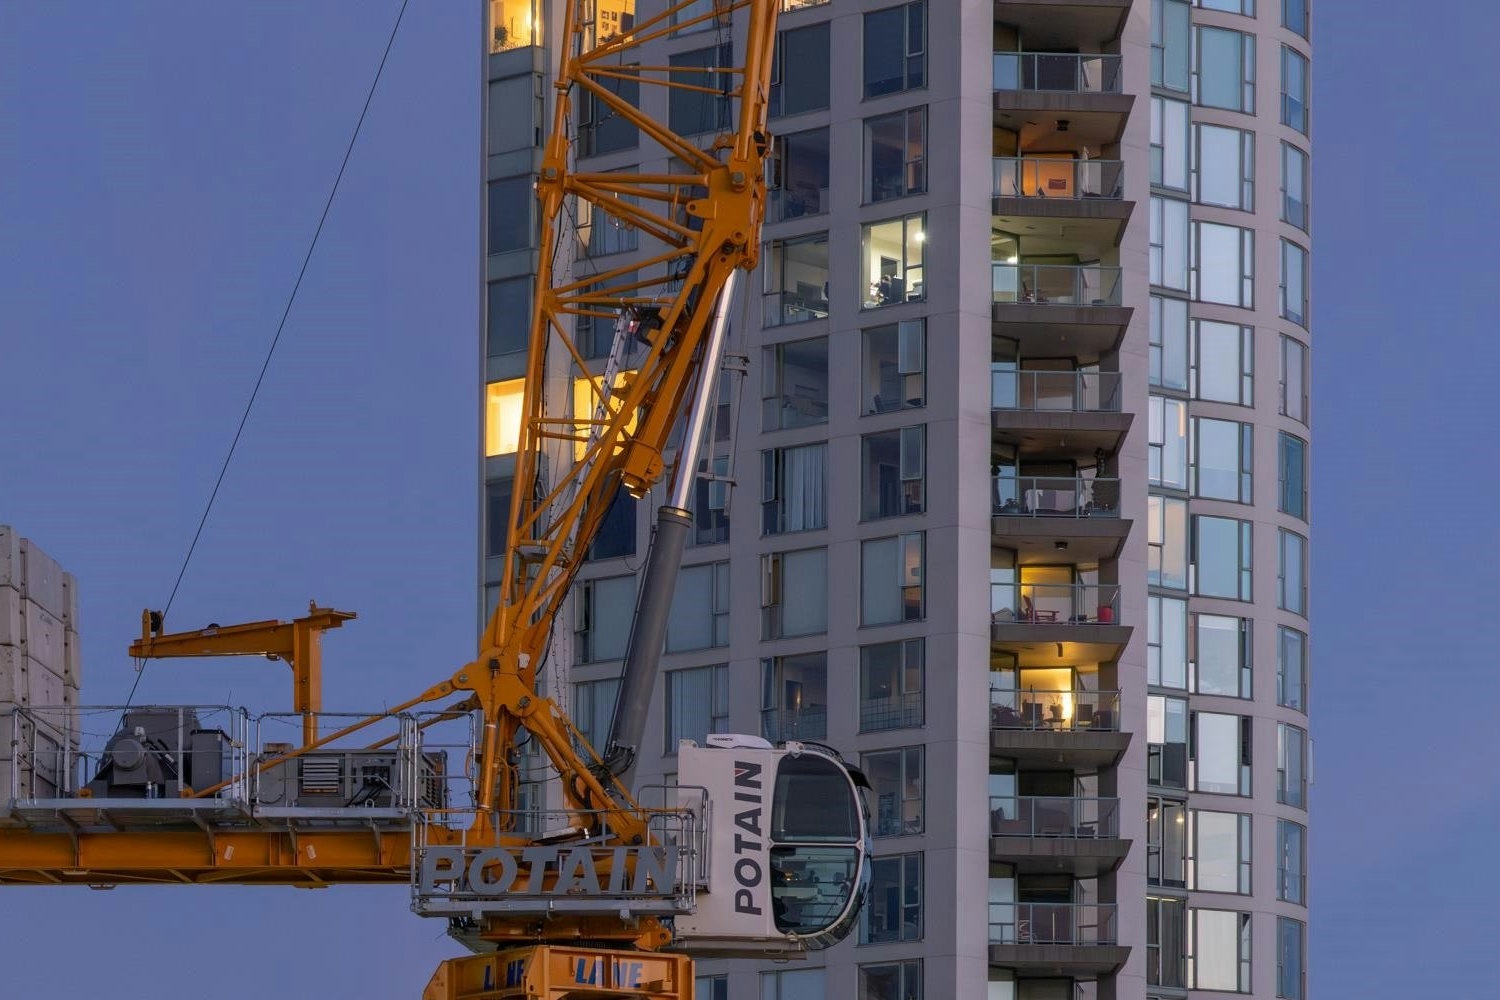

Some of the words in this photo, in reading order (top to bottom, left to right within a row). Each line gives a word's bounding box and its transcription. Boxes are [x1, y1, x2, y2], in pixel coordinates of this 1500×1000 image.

[734, 760, 762, 916] POTAIN
[419, 846, 678, 895] POTAIN
[575, 957, 644, 989] LANE
